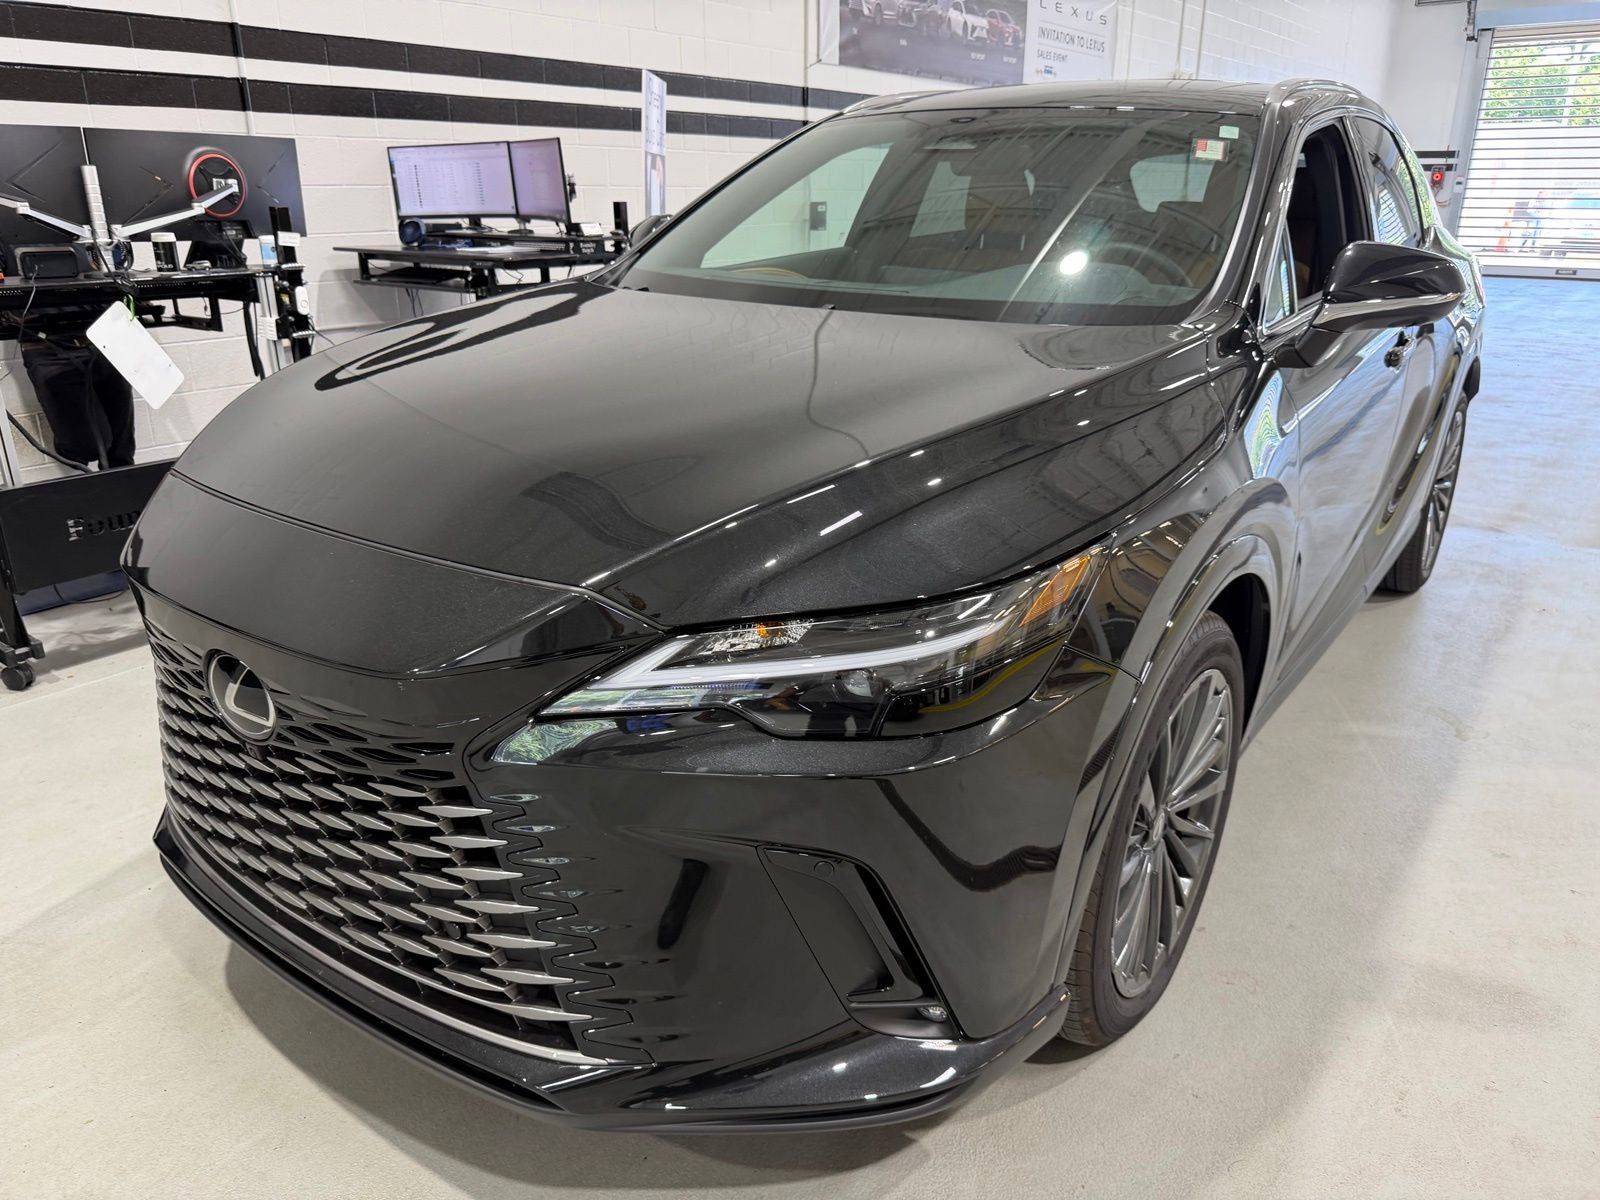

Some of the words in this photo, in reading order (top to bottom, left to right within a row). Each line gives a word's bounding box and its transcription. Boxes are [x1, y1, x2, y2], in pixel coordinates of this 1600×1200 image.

[1040, 0, 1107, 25] LEXUS
[1038, 26, 1075, 45] INVITATION
[1077, 35, 1085, 48] TO
[1086, 38, 1105, 53] LEXUS
[1037, 49, 1052, 60] SALES
[1053, 52, 1068, 63] EVENT
